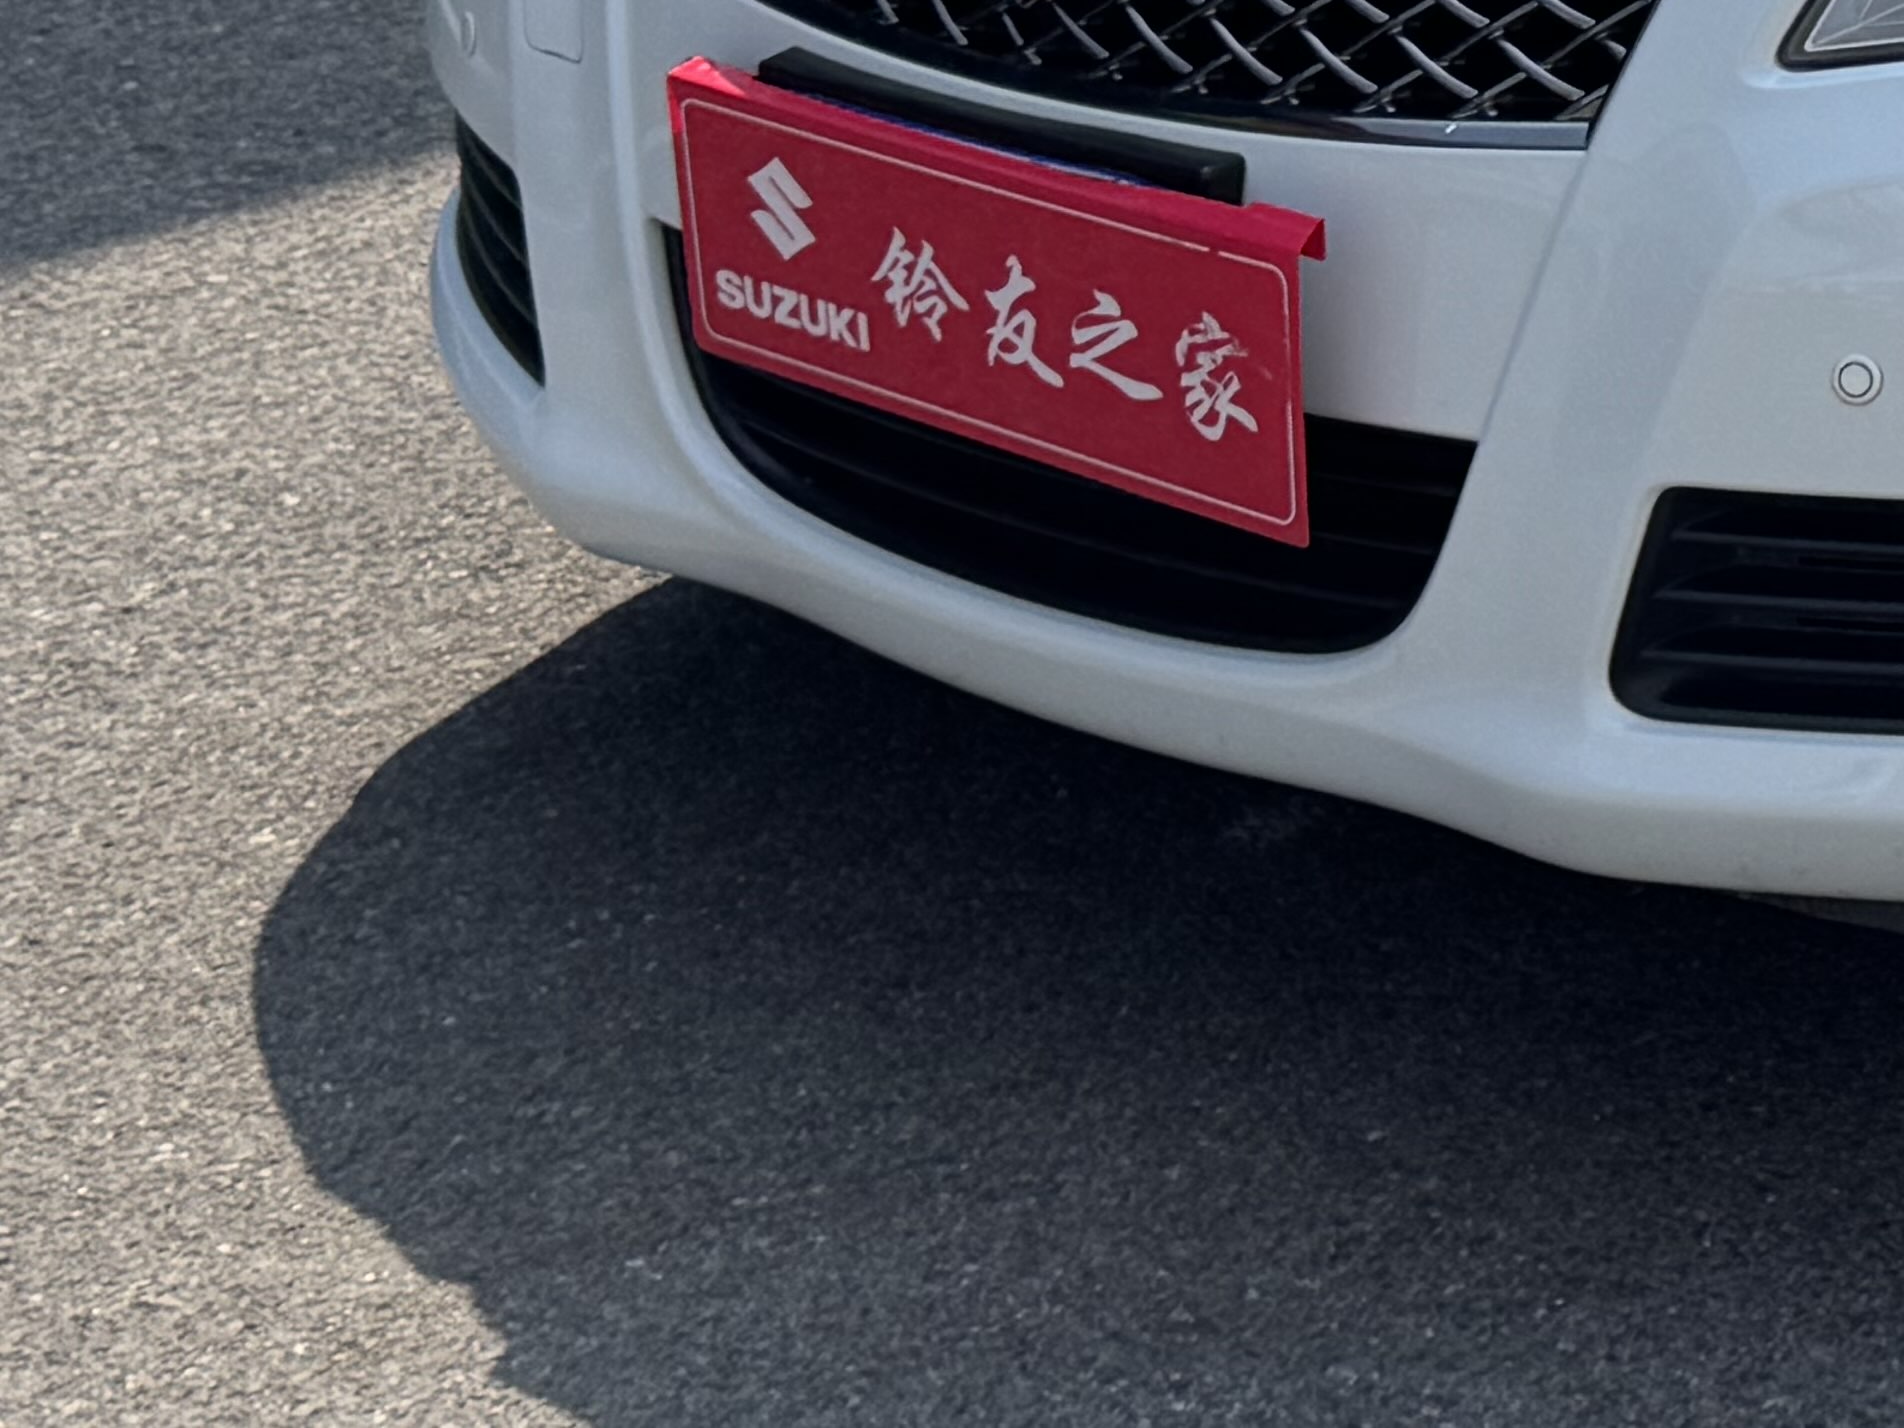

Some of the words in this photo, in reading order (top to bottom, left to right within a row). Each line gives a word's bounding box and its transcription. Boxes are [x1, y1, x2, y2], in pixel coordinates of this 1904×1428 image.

[715, 269, 870, 352] SUZUKI
[871, 226, 1259, 442] 铃友之家
